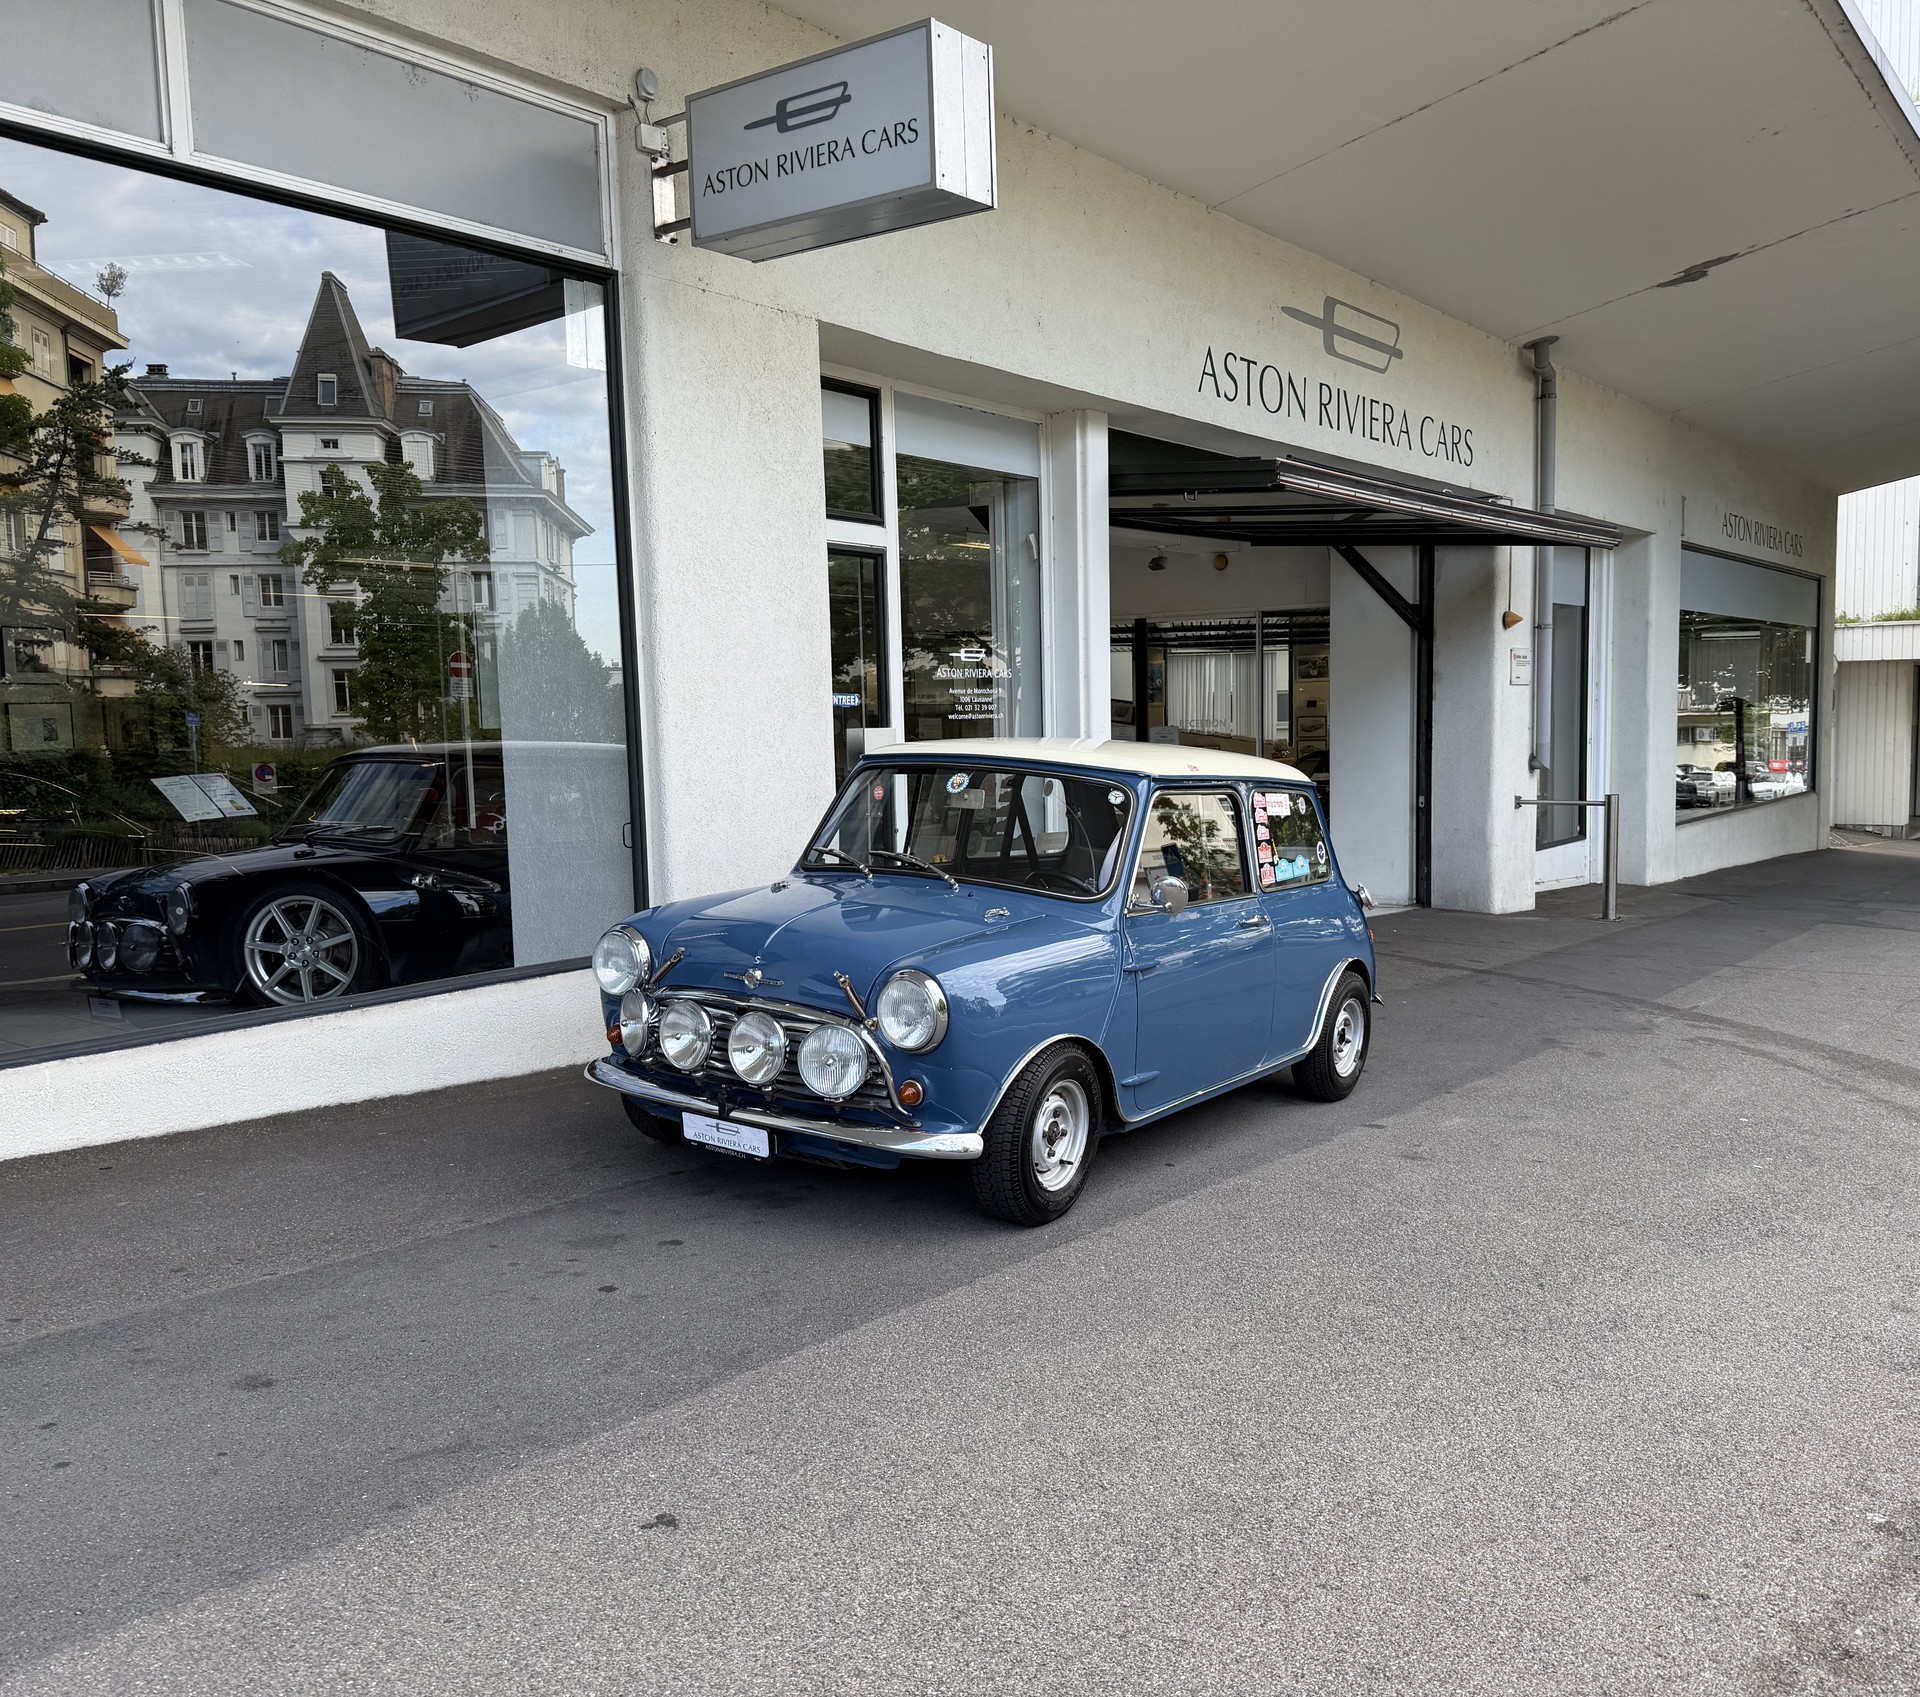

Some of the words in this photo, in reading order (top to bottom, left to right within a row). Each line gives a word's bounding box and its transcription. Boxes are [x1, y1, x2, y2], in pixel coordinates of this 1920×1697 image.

[702, 158, 769, 197] ASTON
[777, 136, 856, 178] RIVIERA
[861, 118, 919, 155] CARS
[1197, 345, 1308, 423] ASTON
[1318, 382, 1413, 451] RIVIERA
[1419, 415, 1474, 468] CARS
[1721, 511, 1753, 544] ASTON
[1754, 521, 1783, 552] RIVIERA
[1784, 531, 1804, 557] CARS
[936, 667, 962, 678] ASTON
[964, 667, 993, 678] RIVIERA
[994, 668, 1013, 679] CARS
[833, 695, 855, 706] NTREE
[753, 955, 761, 964] S
[693, 1131, 716, 1143] ASTON
[716, 1137, 742, 1149] RIVIERA
[742, 1143, 761, 1154] CARS
